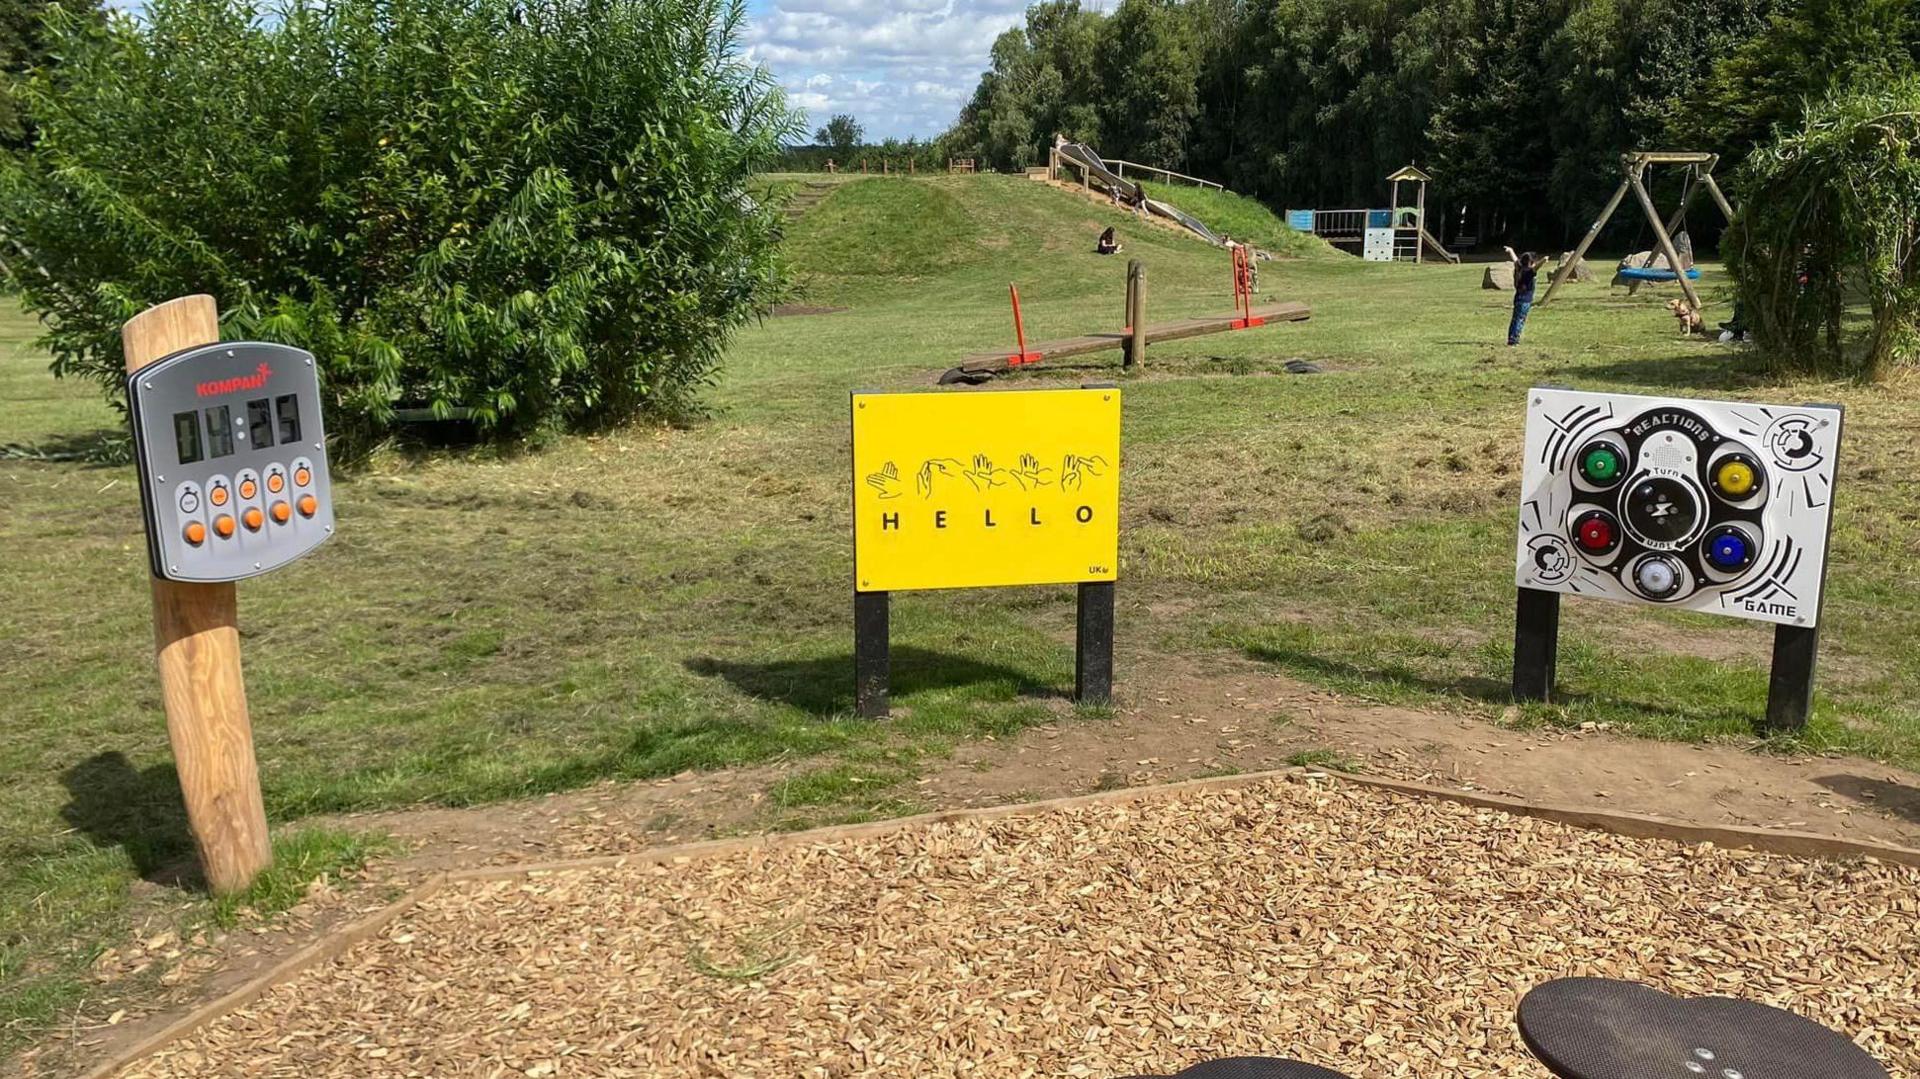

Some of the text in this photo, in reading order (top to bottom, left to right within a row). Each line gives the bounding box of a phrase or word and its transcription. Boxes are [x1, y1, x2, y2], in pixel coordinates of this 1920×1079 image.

[196, 374, 262, 397] KOMPAN
[1633, 413, 1709, 441] REACTIONS
[1653, 467, 1679, 477] Turn
[1089, 566, 1102, 574] UK
[1744, 600, 1797, 617] GAME
